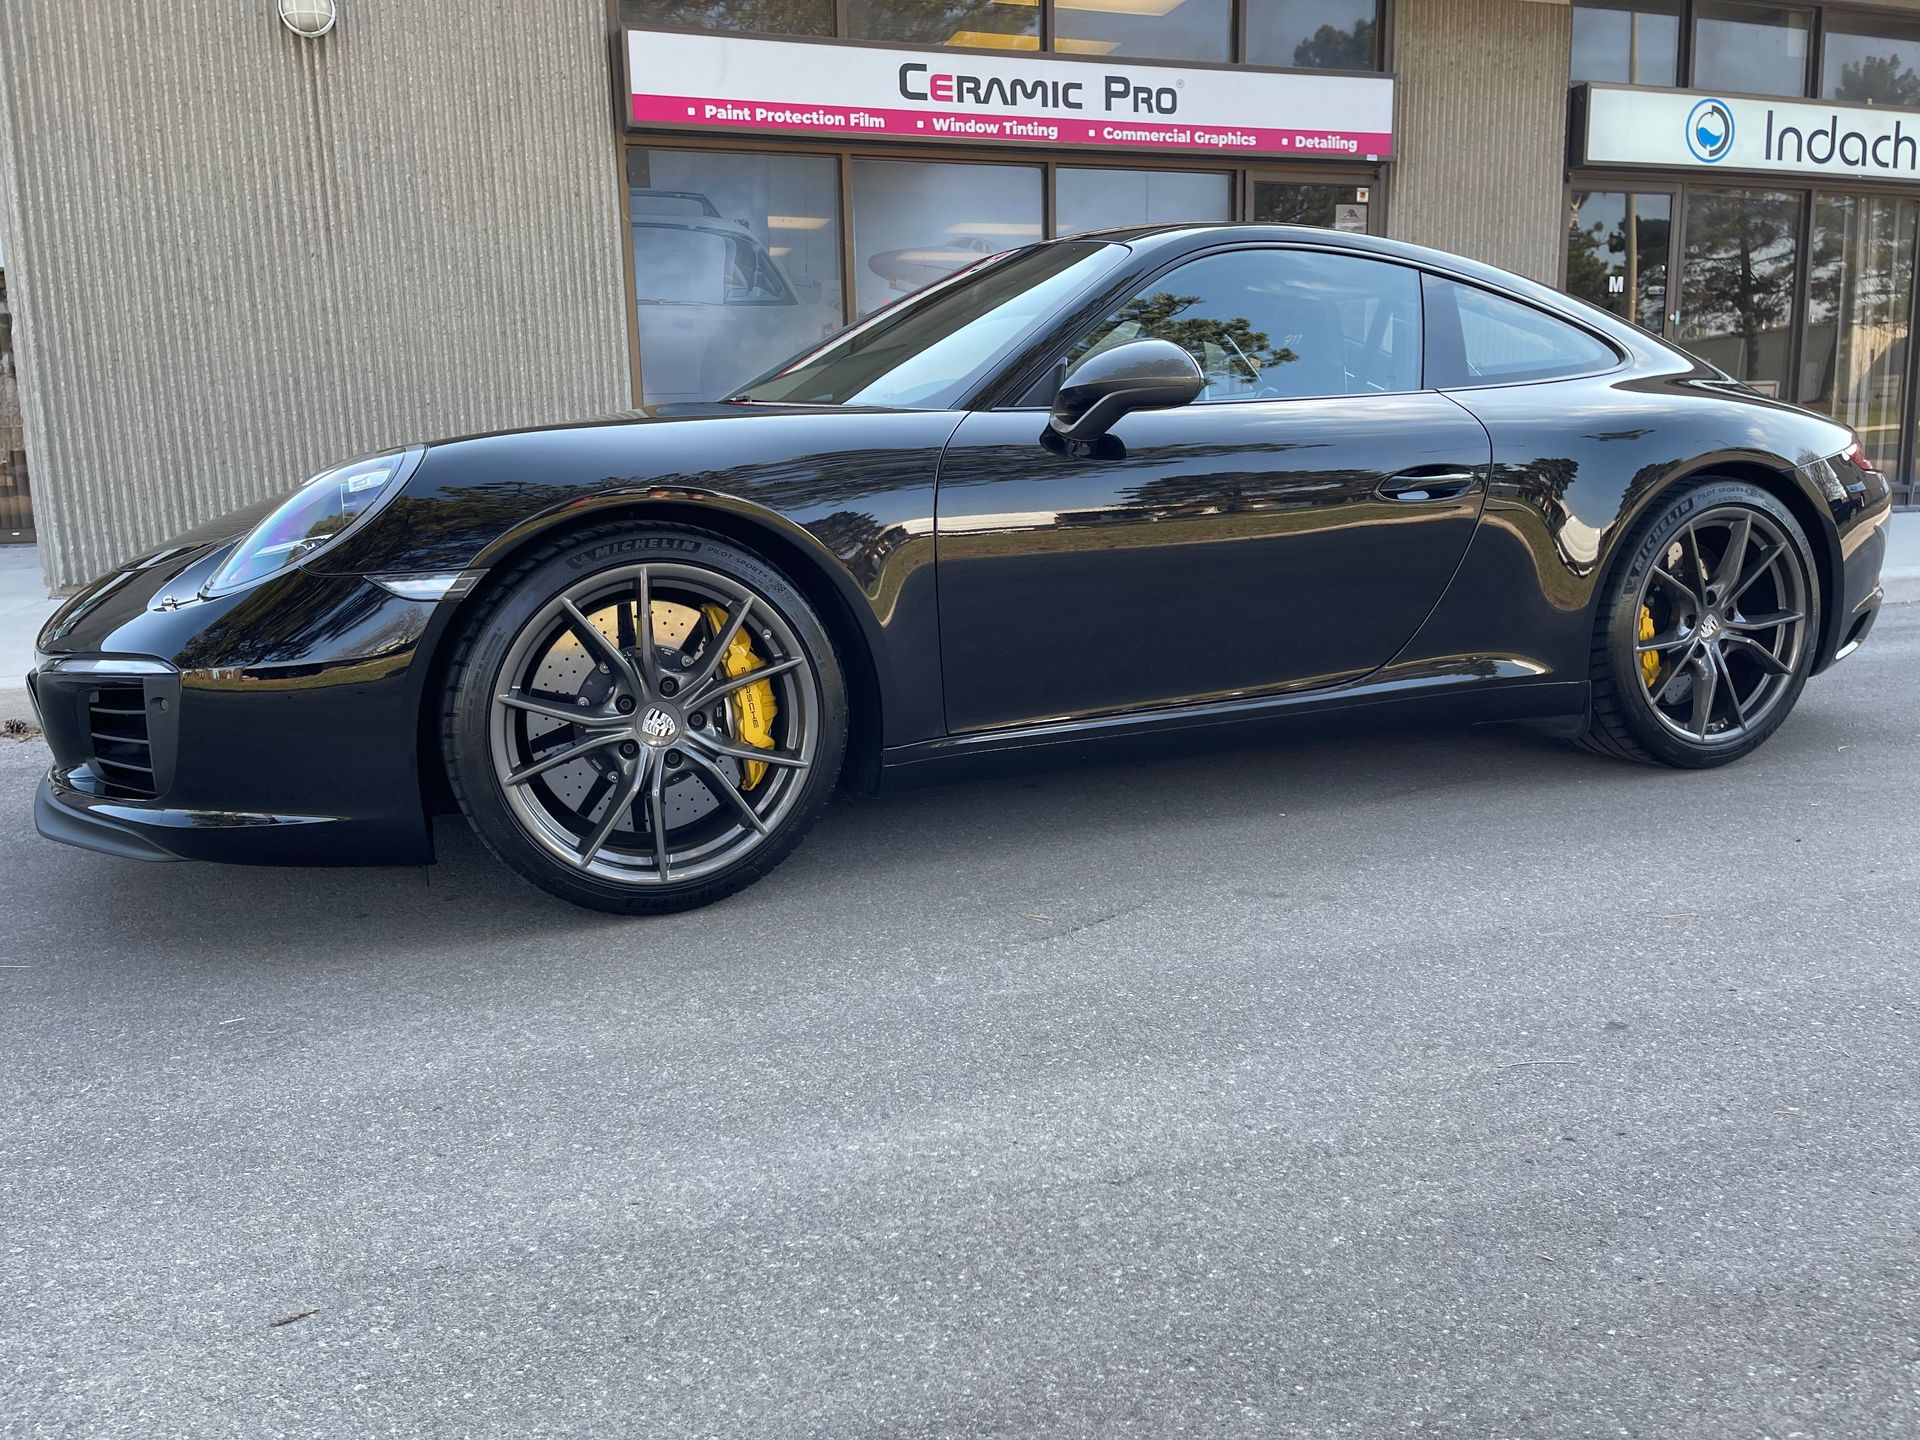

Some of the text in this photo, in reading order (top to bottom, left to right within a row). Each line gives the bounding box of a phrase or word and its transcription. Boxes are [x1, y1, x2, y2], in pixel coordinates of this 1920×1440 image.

[705, 104, 1358, 153] Paint Protection Film Window Tinting Commercial Graphics Detailing
[1608, 276, 1625, 294] M
[595, 538, 695, 561] MICHELIN
[1633, 500, 1692, 572] MICHELIN
[707, 546, 733, 559] PILOT
[736, 557, 762, 575] SPORT
[740, 666, 760, 729] PRSCHE
